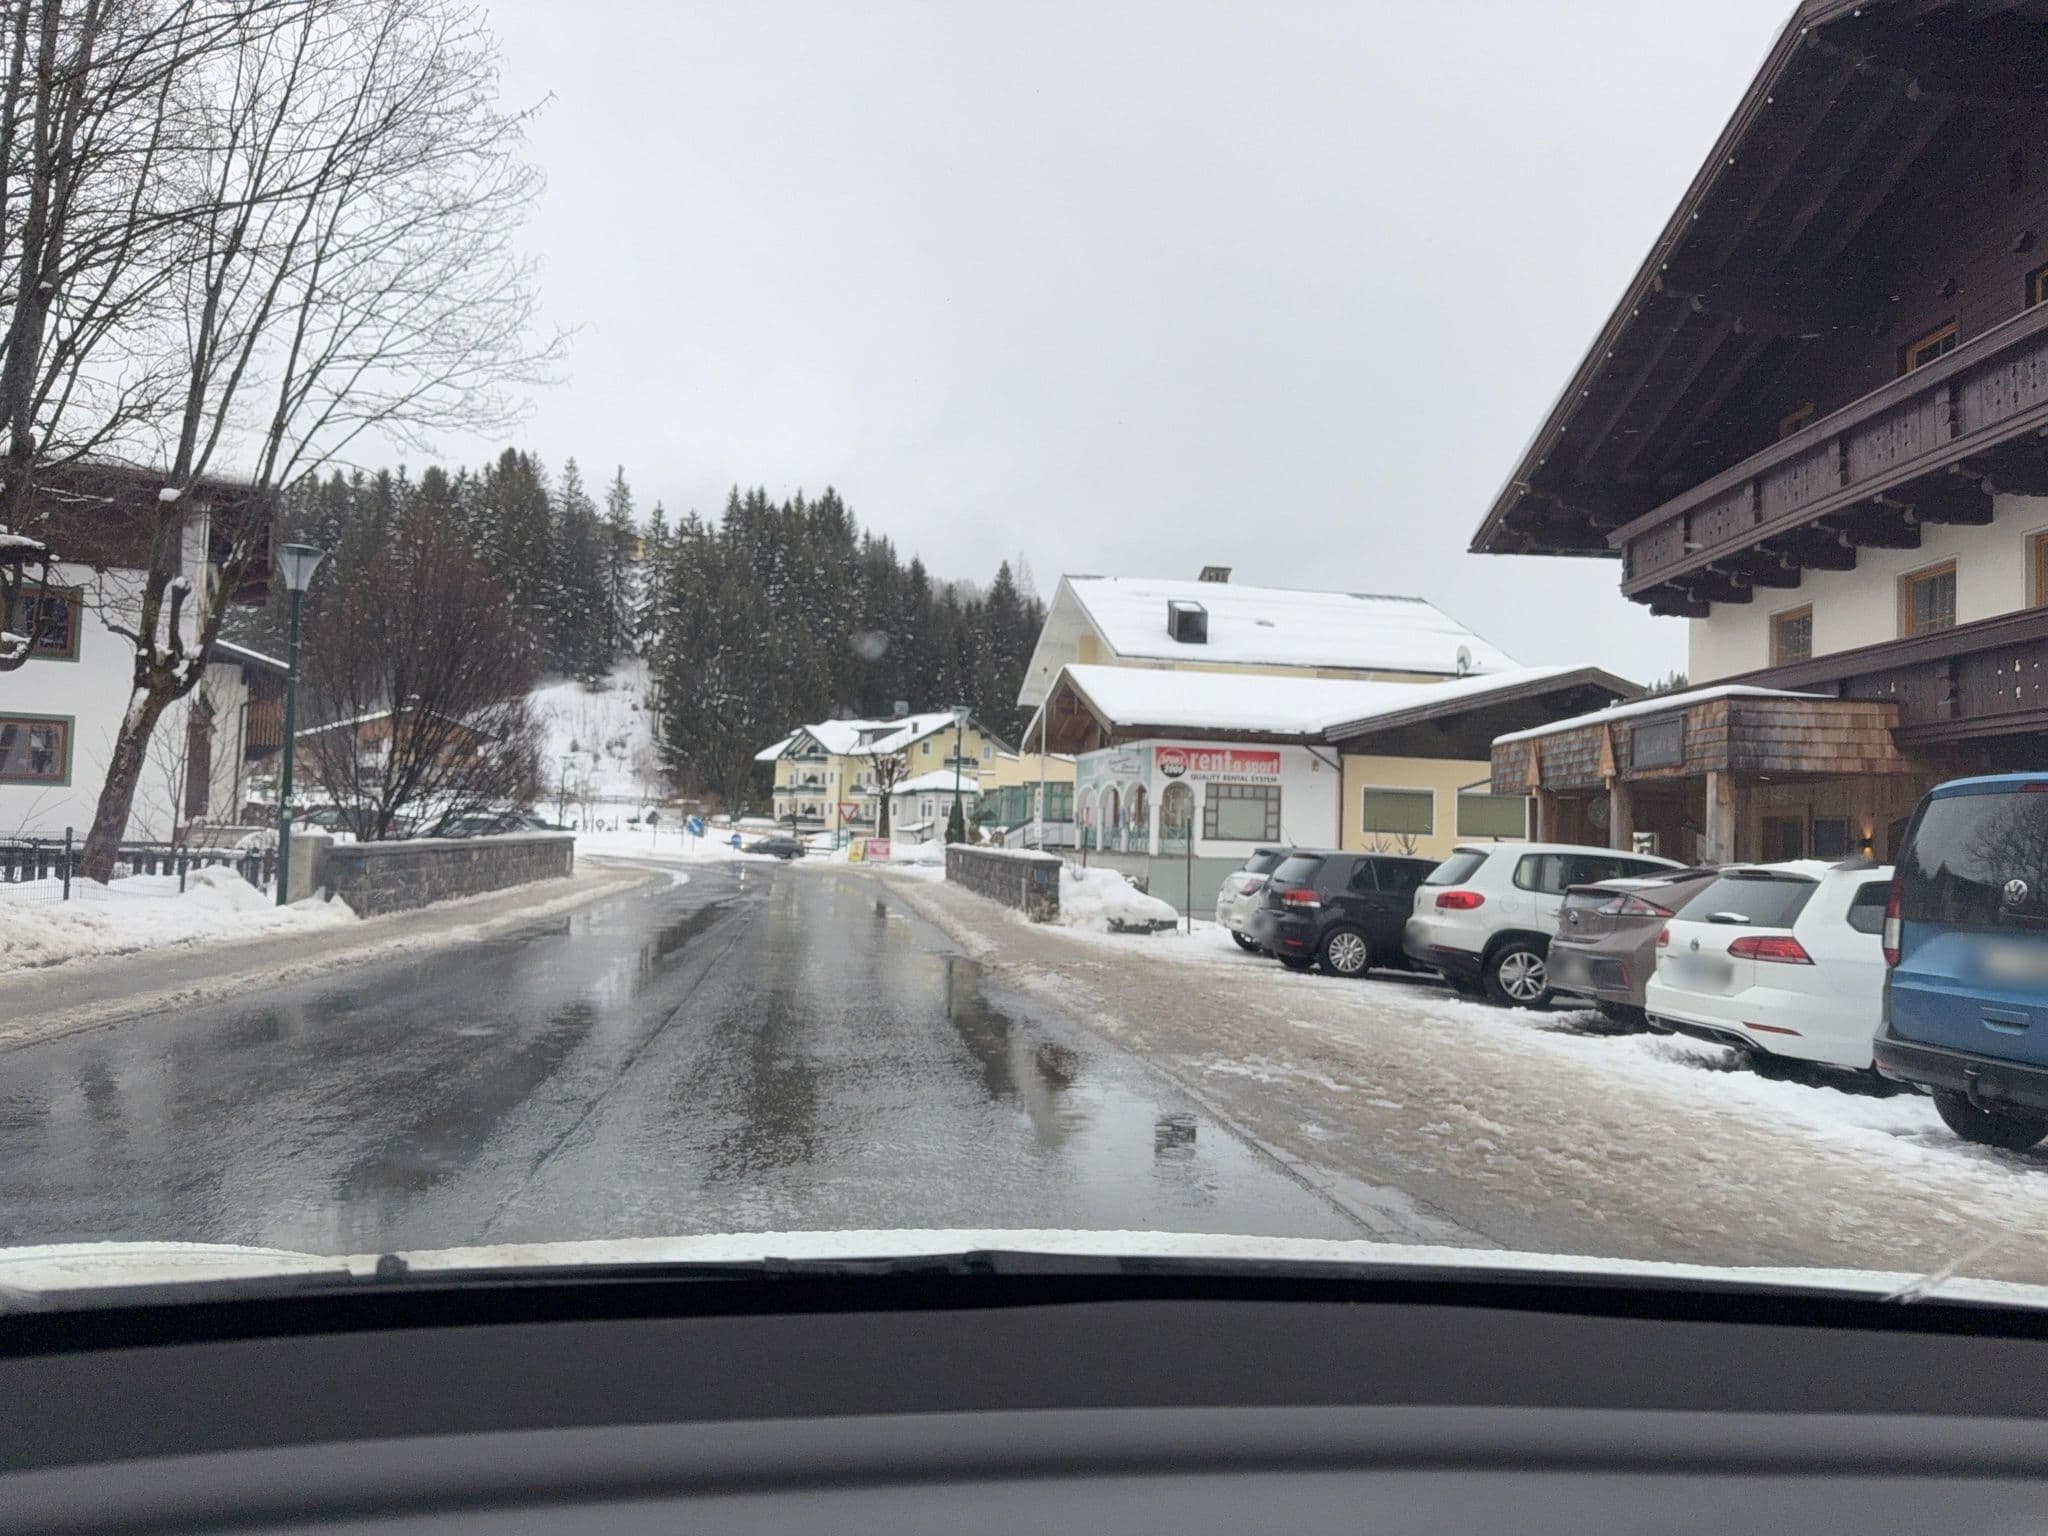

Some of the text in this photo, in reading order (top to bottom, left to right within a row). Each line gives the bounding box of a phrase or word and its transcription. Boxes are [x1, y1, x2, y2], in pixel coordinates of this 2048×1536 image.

[1189, 750, 1232, 771] rent
[1244, 758, 1279, 773] sport
[1190, 774, 1220, 782] QUALITY
[1251, 775, 1278, 783] SYSTEM
